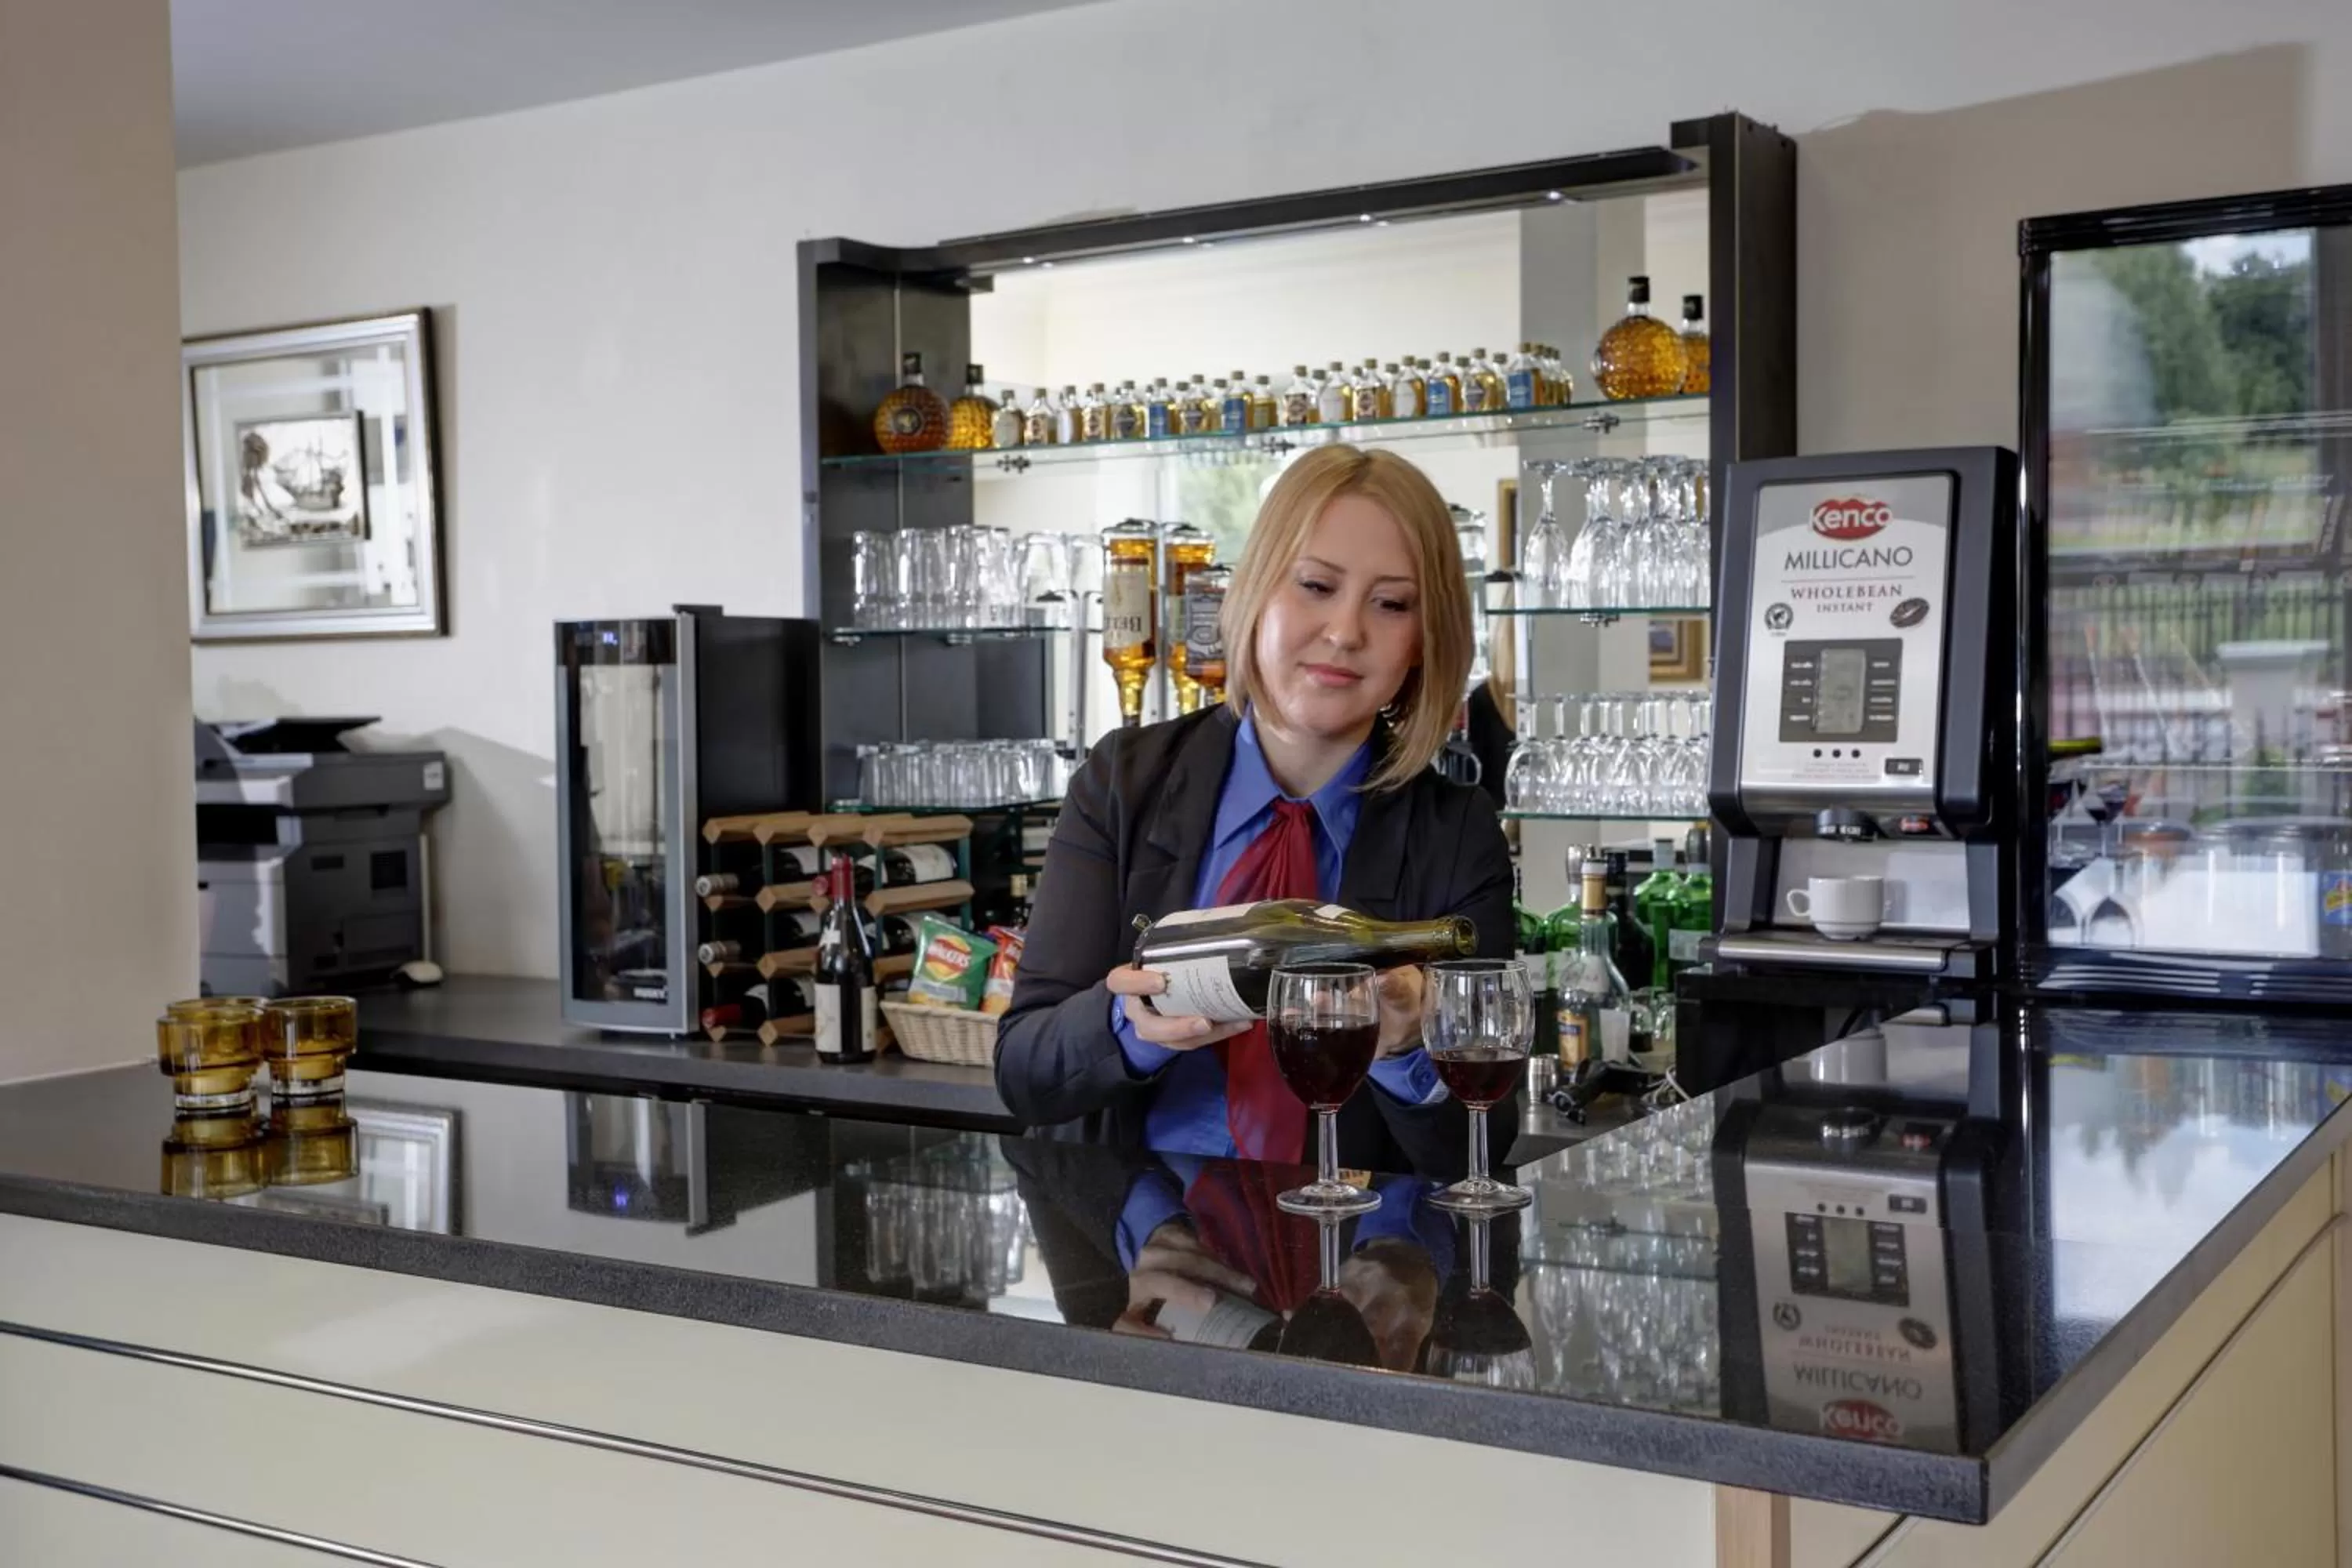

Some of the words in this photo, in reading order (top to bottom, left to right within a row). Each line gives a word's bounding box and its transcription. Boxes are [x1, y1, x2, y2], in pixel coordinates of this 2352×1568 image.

[1809, 506, 1893, 532] Kenco
[1784, 546, 1913, 571] MILLICANO
[1791, 585, 1903, 600] WHOLEBEAN
[1817, 601, 1874, 614] INSTANT
